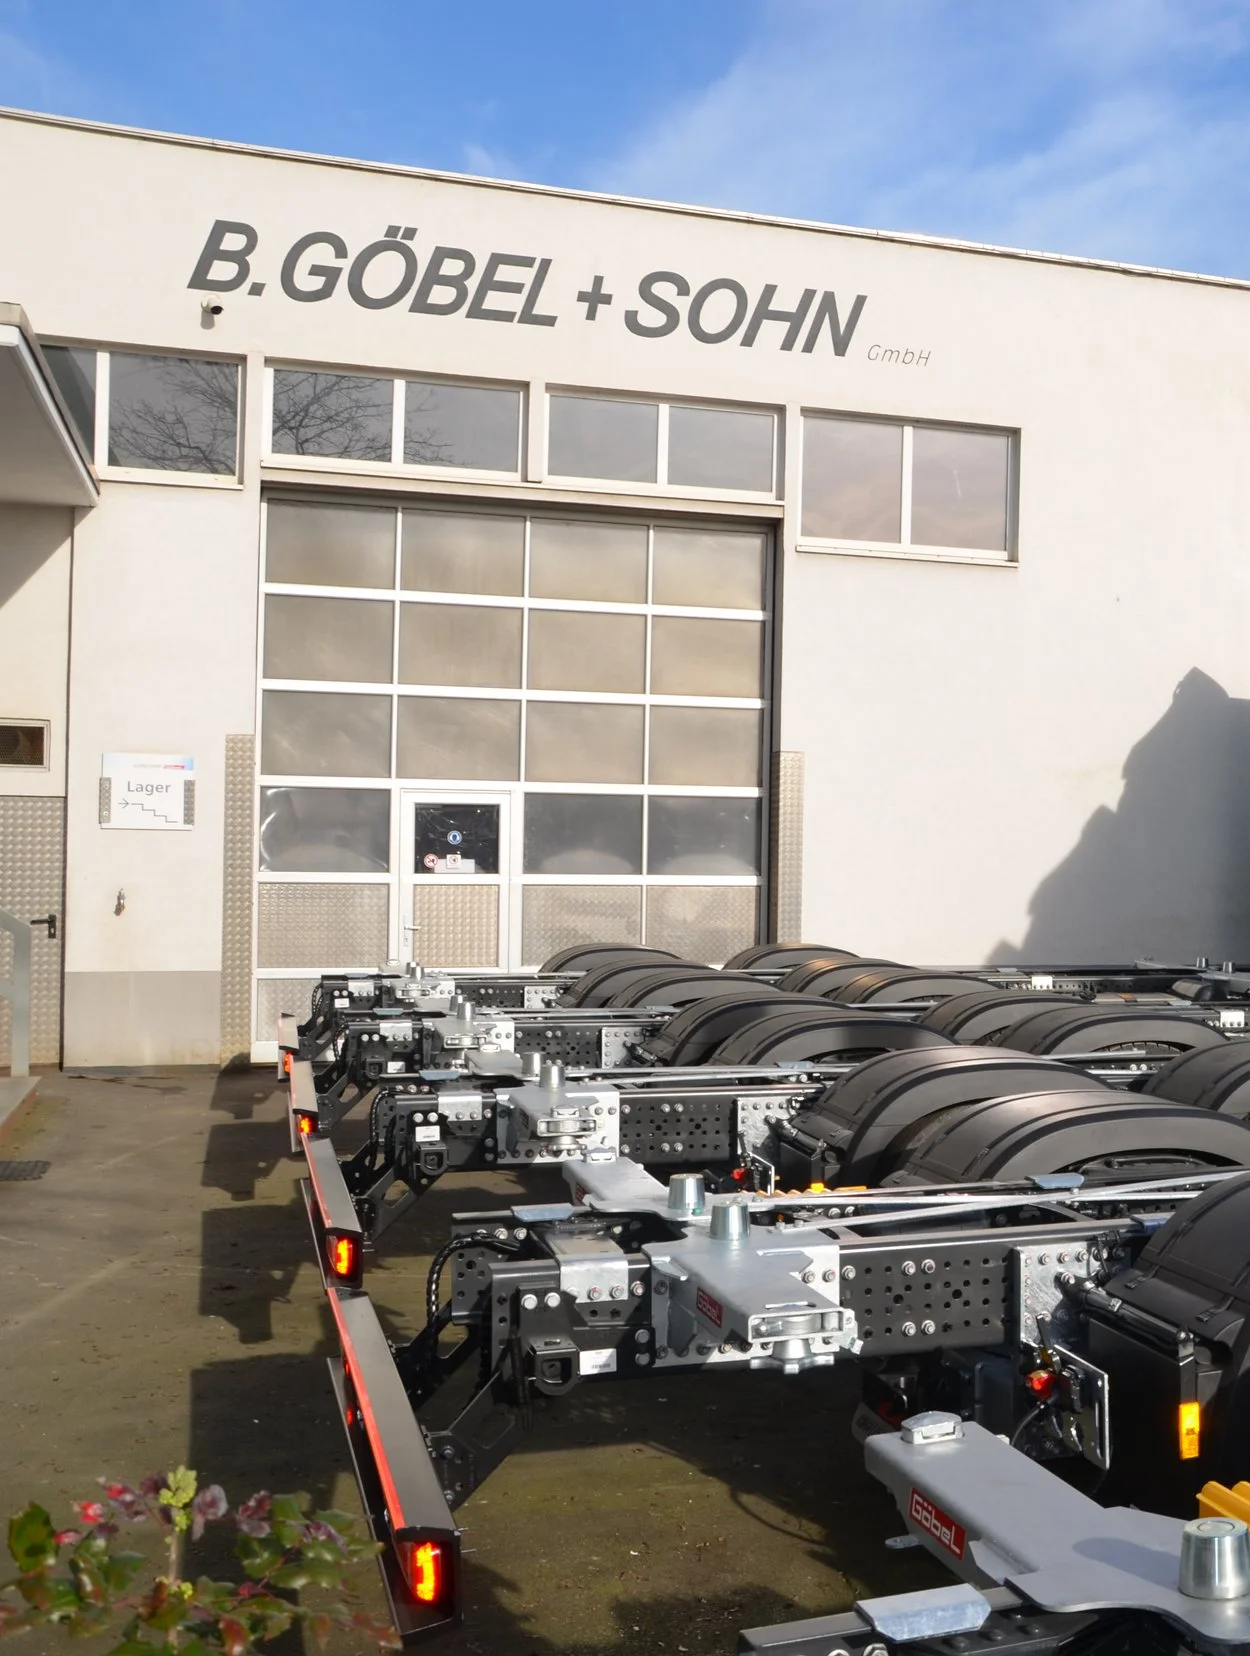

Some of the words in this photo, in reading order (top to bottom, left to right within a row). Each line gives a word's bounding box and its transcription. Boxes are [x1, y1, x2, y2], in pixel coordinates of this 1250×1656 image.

[577, 274, 614, 322] +
[624, 270, 868, 358] SOHN
[866, 344, 932, 366] GmbH
[127, 781, 171, 796] Lager
